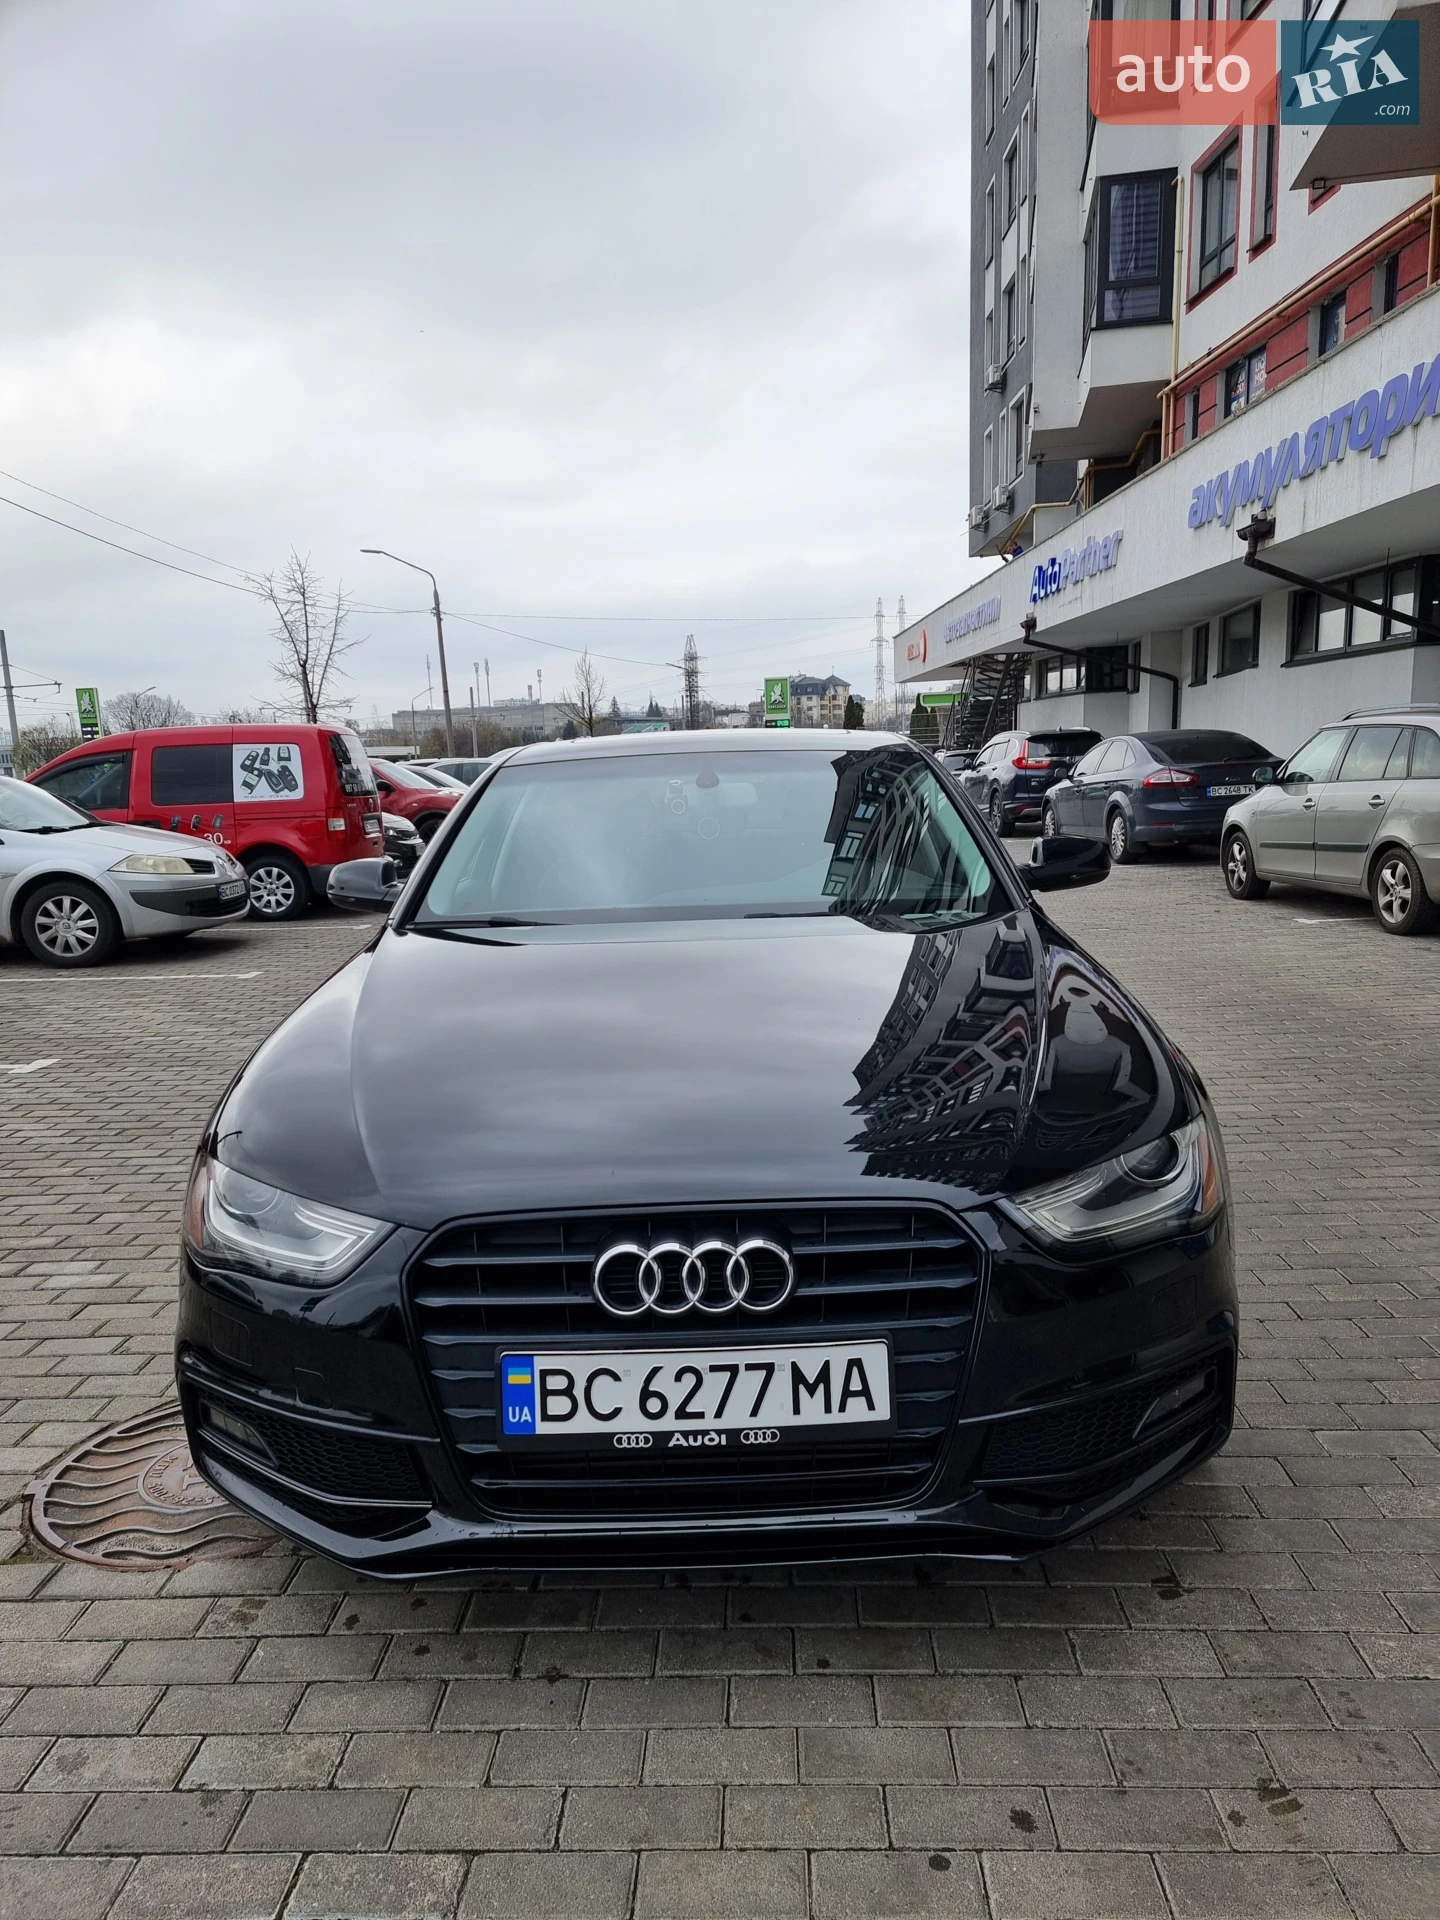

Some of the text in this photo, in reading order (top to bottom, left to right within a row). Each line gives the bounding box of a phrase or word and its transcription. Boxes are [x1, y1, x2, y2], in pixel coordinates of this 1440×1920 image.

[1224, 786, 1241, 795] 2648
[1243, 785, 1254, 794] TK
[539, 1357, 876, 1422] BC 6277 MA
[508, 1406, 533, 1423] UA
[667, 1432, 727, 1448] Audi
